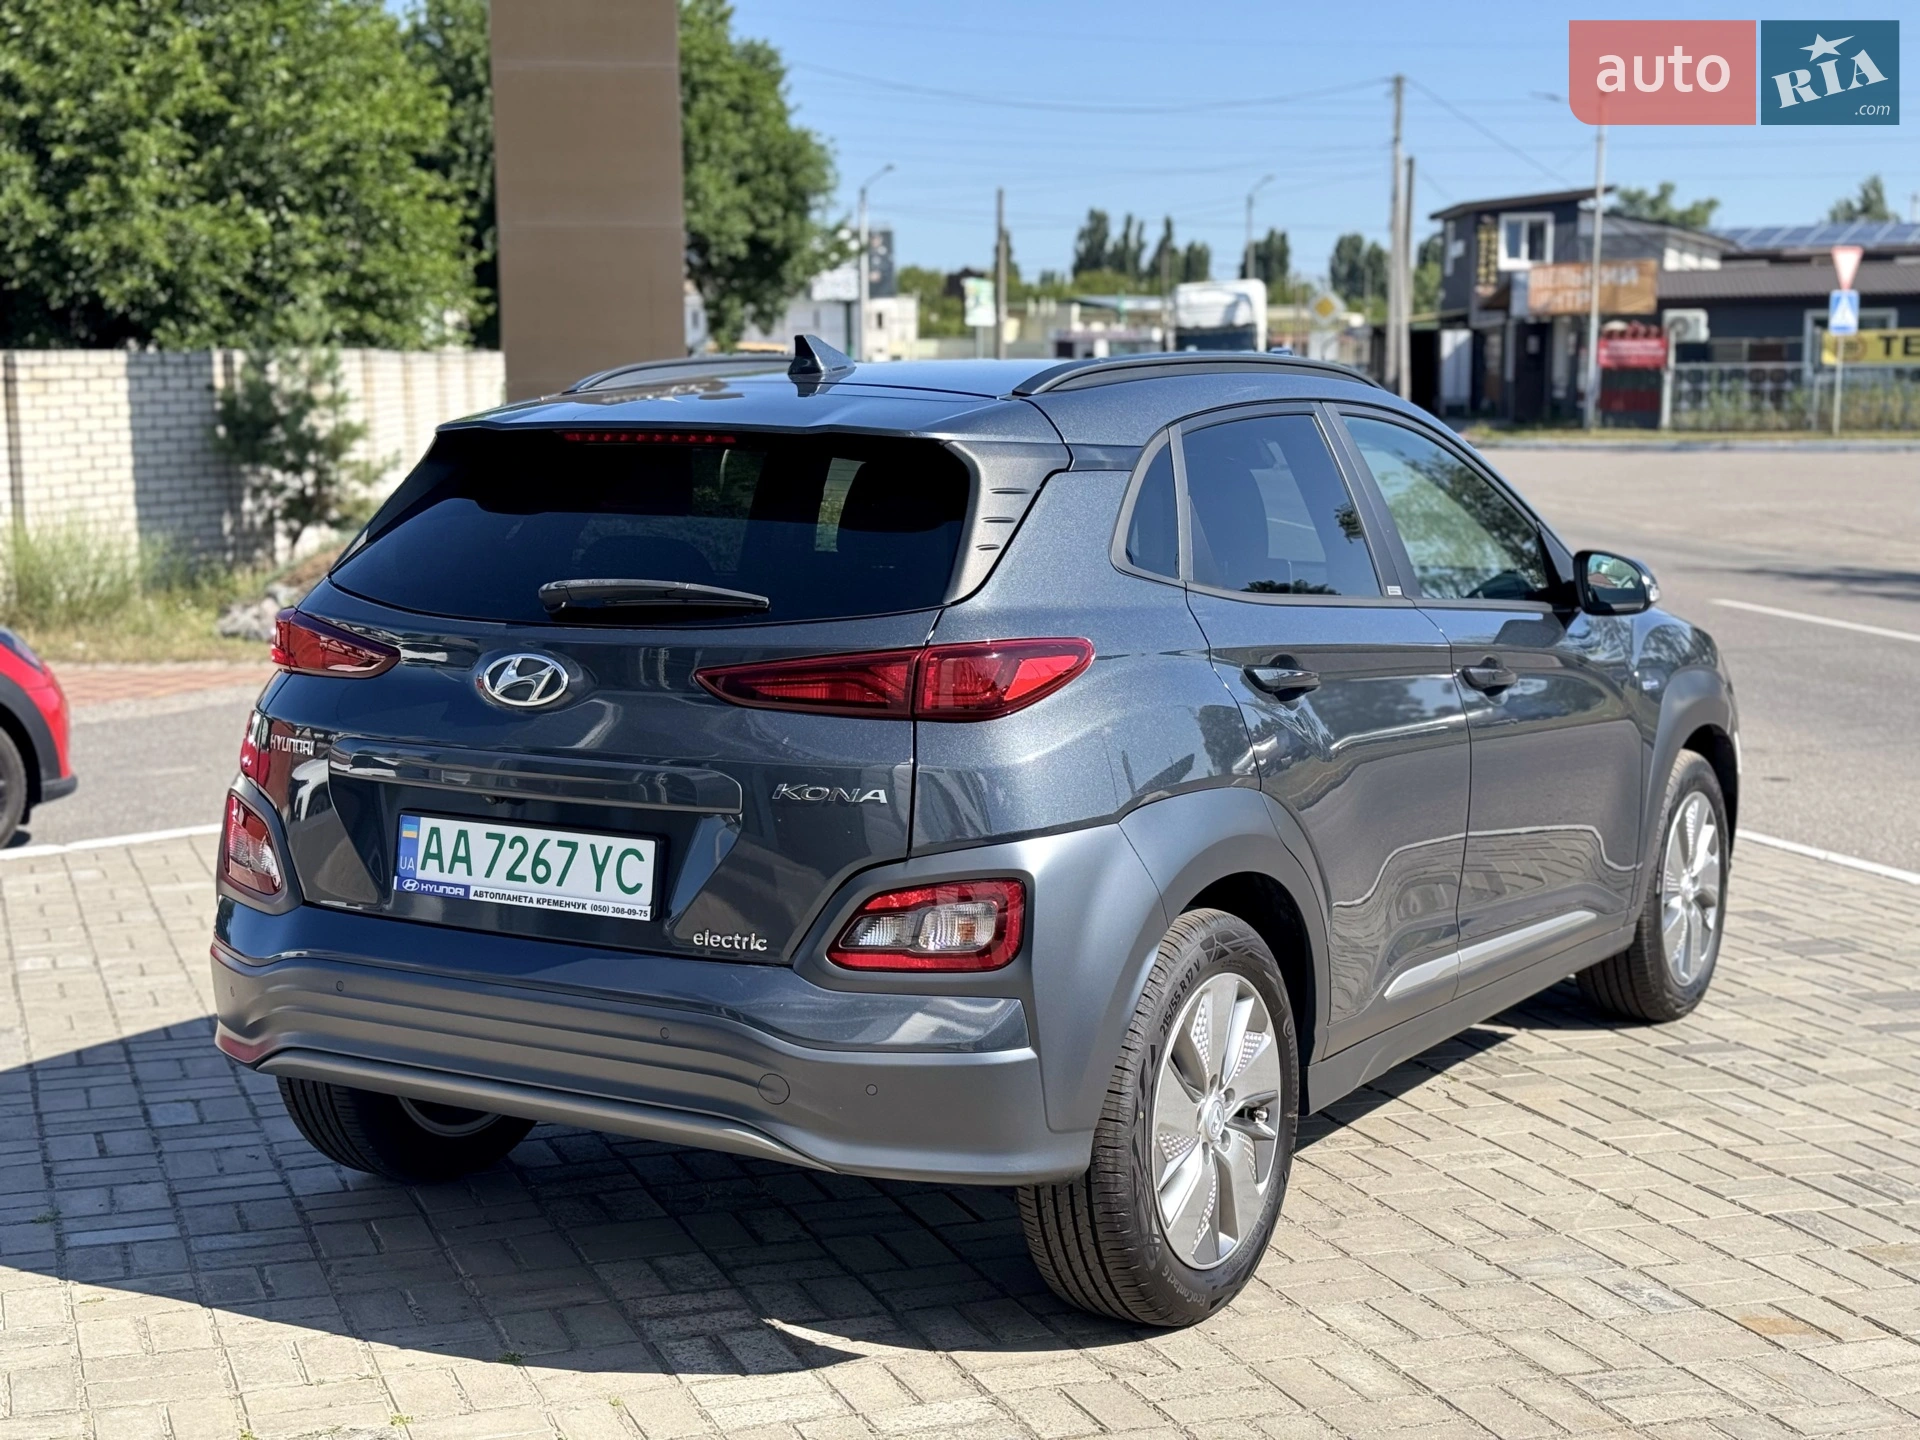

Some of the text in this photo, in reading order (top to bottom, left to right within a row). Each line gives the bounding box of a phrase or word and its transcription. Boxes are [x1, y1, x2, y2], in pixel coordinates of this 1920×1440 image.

[269, 734, 315, 756] HYUNDAI
[772, 783, 888, 804] KONA
[400, 855, 415, 871] UA
[420, 826, 645, 896] AA 7267 YC
[420, 882, 465, 896] HYUNDAI
[473, 889, 649, 918] АВТОПЛАНЕТА КРЕМЕНЧУК (050) 308-09-75
[693, 929, 767, 951] electric
[1159, 990, 1182, 1037] 215/55
